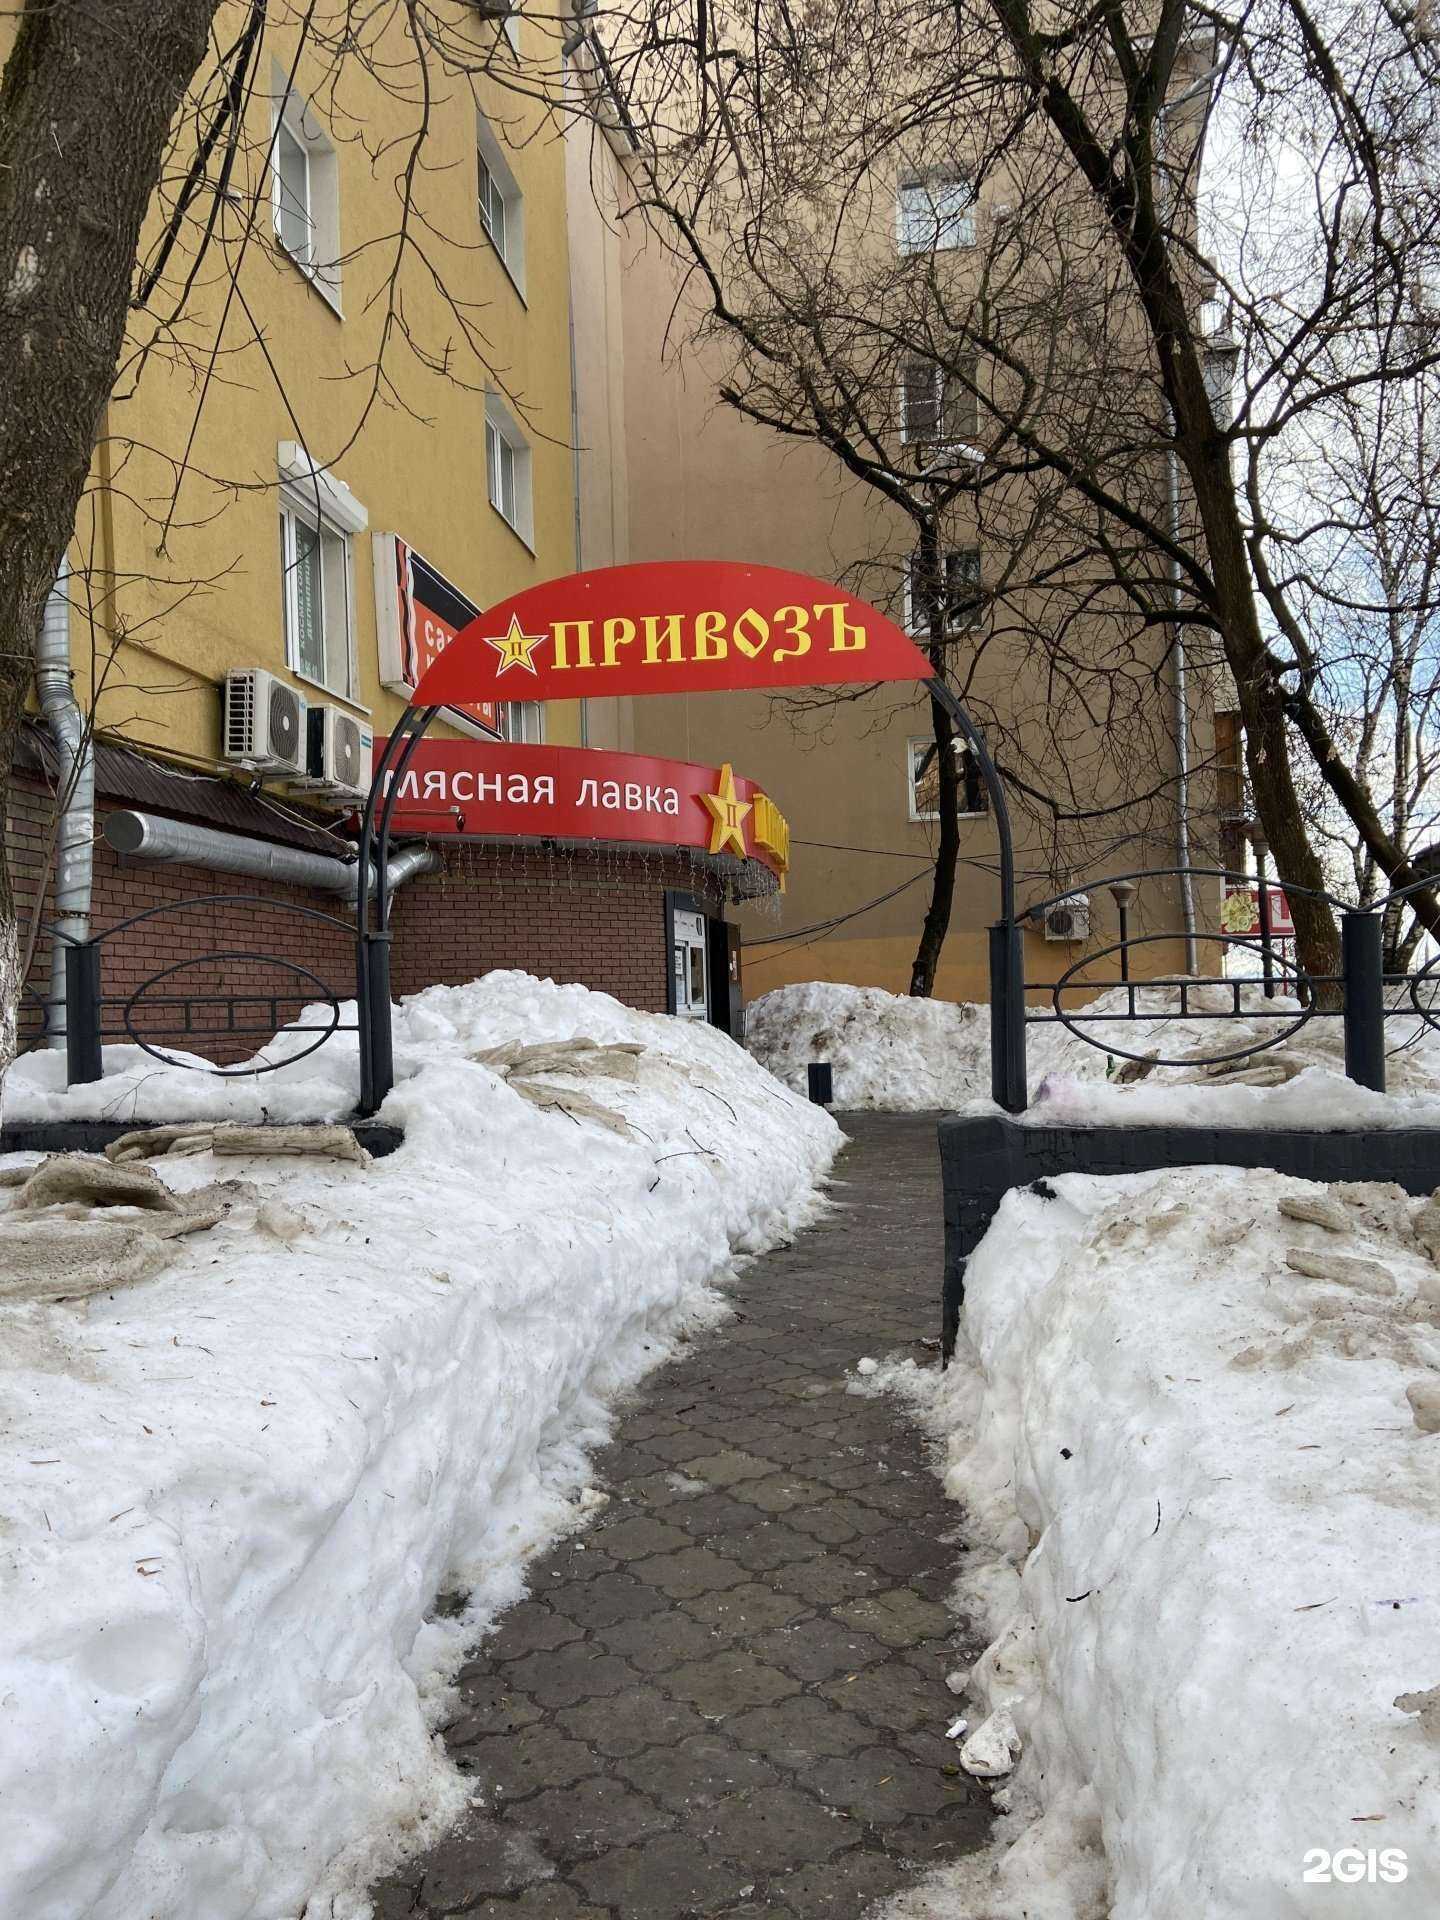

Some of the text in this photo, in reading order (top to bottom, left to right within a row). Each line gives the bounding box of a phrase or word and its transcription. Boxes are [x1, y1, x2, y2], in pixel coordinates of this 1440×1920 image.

[549, 602, 866, 669] ПРИВОЗЪ
[382, 769, 680, 816] мясная лавка
